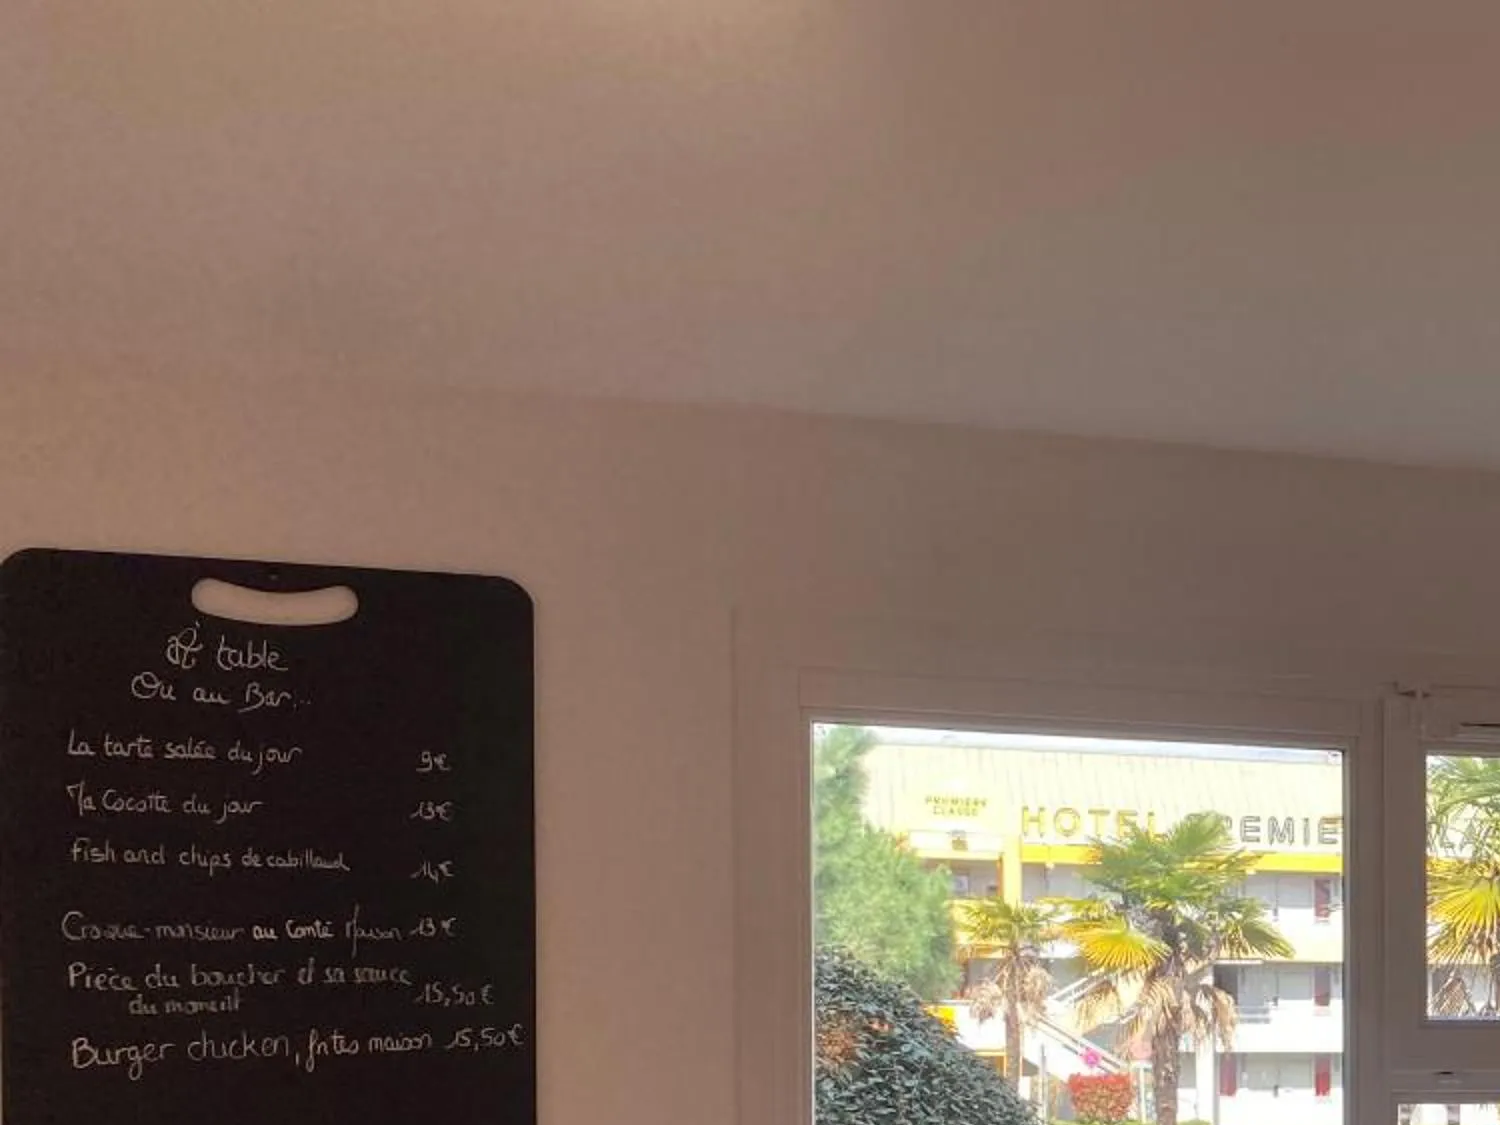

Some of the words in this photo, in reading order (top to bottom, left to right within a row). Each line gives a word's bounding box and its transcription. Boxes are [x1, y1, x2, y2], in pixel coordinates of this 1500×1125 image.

[217, 634, 289, 671] table
[131, 671, 177, 700] Ou
[193, 687, 231, 705] au
[67, 729, 96, 757] La
[103, 733, 153, 758] tarte
[164, 737, 216, 760] salée
[251, 746, 304, 775] jour
[102, 789, 172, 815] Cocotte
[182, 793, 211, 816] du
[215, 795, 264, 825] jour
[1020, 804, 1166, 841] HOTEL
[123, 843, 166, 866] and
[178, 841, 232, 877] chips
[252, 924, 279, 941] au
[145, 962, 180, 990] du
[191, 963, 286, 988] boucher
[350, 965, 413, 986] sauce
[128, 992, 158, 1016] du
[71, 1035, 177, 1081] Burger
[305, 1026, 359, 1072] frites
[368, 1030, 433, 1053] maison
